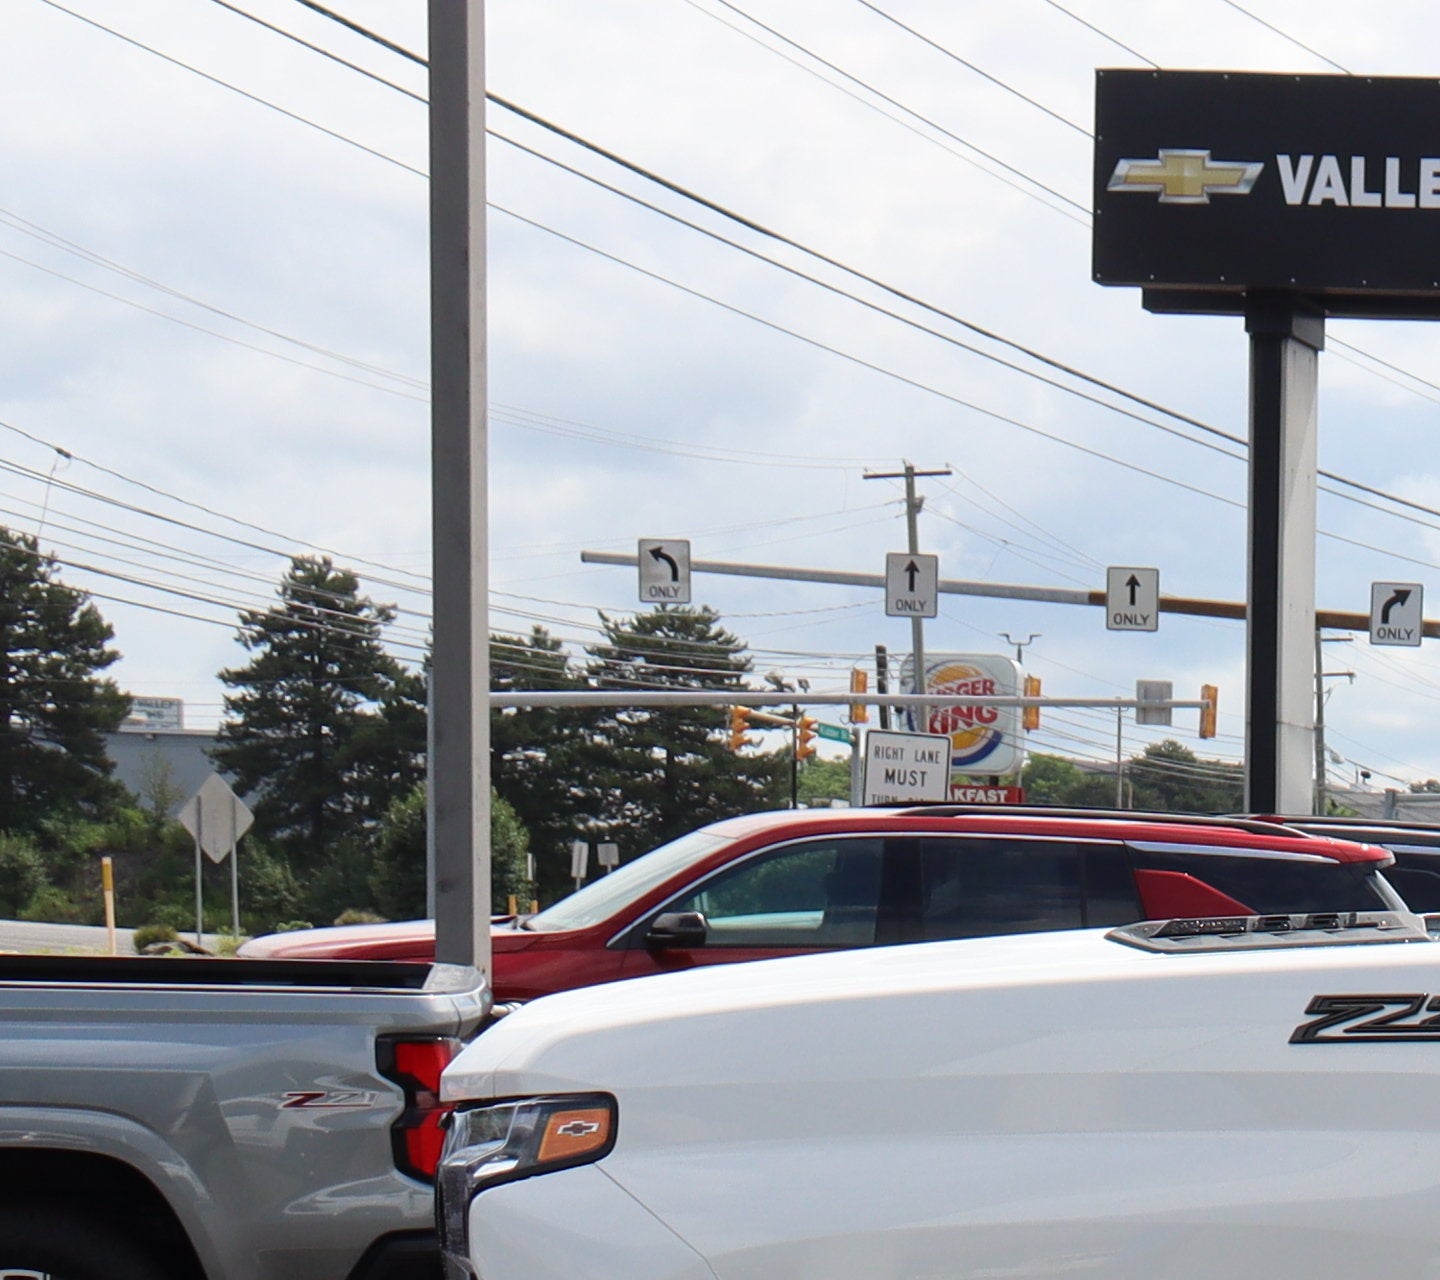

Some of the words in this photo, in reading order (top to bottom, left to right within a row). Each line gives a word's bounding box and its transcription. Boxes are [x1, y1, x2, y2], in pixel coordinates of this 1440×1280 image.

[649, 586, 681, 598] ONLY
[895, 599, 927, 612] ONLY
[1113, 613, 1150, 626] ONLY
[1376, 627, 1414, 641] ONLY
[874, 745, 905, 761] RIGHT
[914, 749, 941, 764] LANE
[884, 768, 928, 788] MUST
[277, 1090, 379, 1110] Z71
